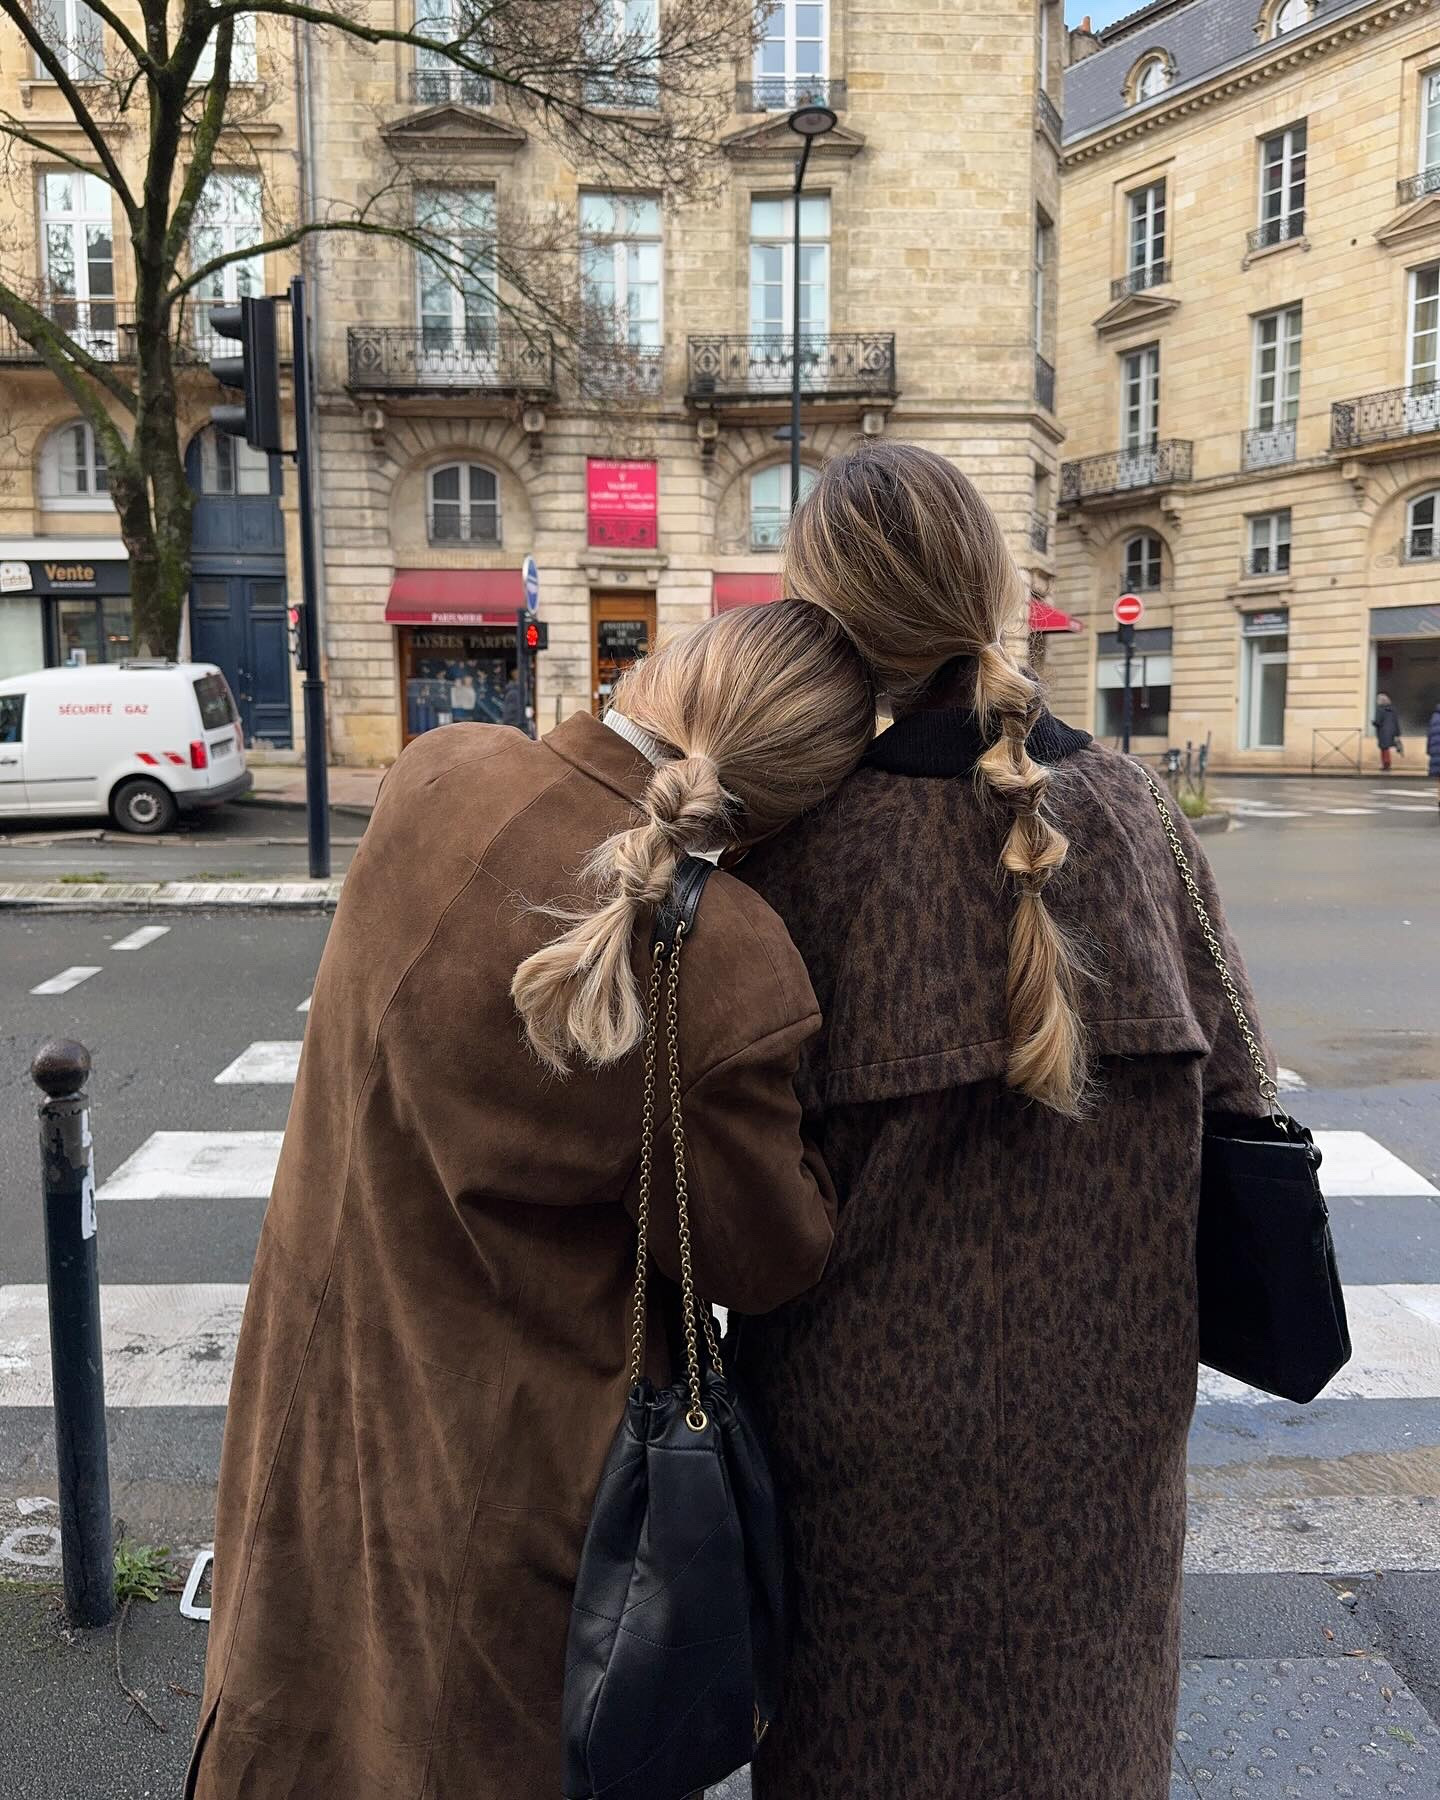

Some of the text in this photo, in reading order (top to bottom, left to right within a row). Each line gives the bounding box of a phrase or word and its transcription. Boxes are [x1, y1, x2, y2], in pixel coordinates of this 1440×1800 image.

[44, 563, 95, 581] Vente
[59, 701, 149, 715] SÉCURITÉ GAZ
